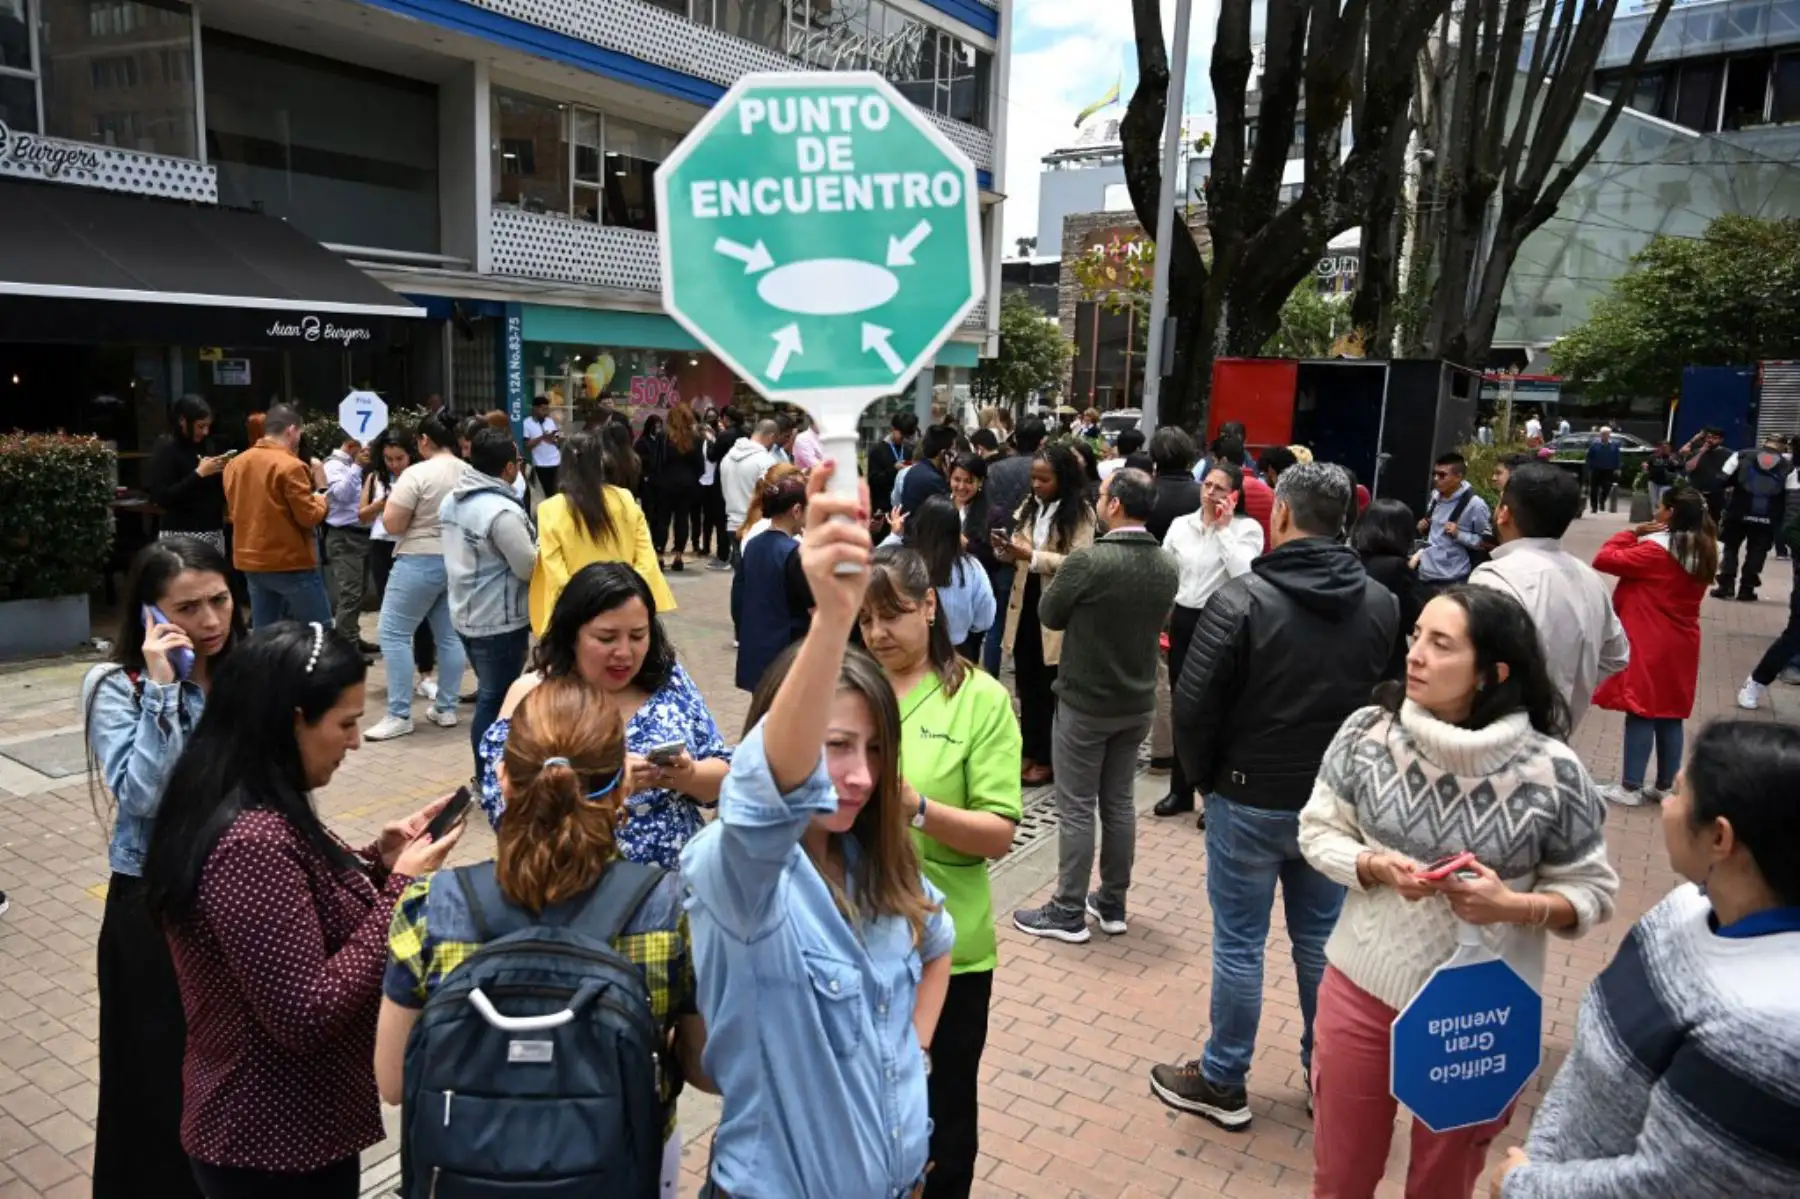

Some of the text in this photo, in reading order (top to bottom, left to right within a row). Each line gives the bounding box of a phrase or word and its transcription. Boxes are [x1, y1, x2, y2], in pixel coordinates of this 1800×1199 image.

[738, 95, 890, 135] PUNTO
[14, 136, 100, 173] Burgers
[796, 136, 855, 172] DE
[690, 172, 962, 218] ENCUENTRO
[267, 321, 371, 347] Juan Burgers
[510, 372, 521, 394] 12A
[630, 376, 681, 408] 50%
[356, 410, 373, 433] 7
[1428, 1006, 1511, 1037] Avenida
[1445, 1032, 1495, 1053] Gran
[1429, 1054, 1507, 1083] Edificio
